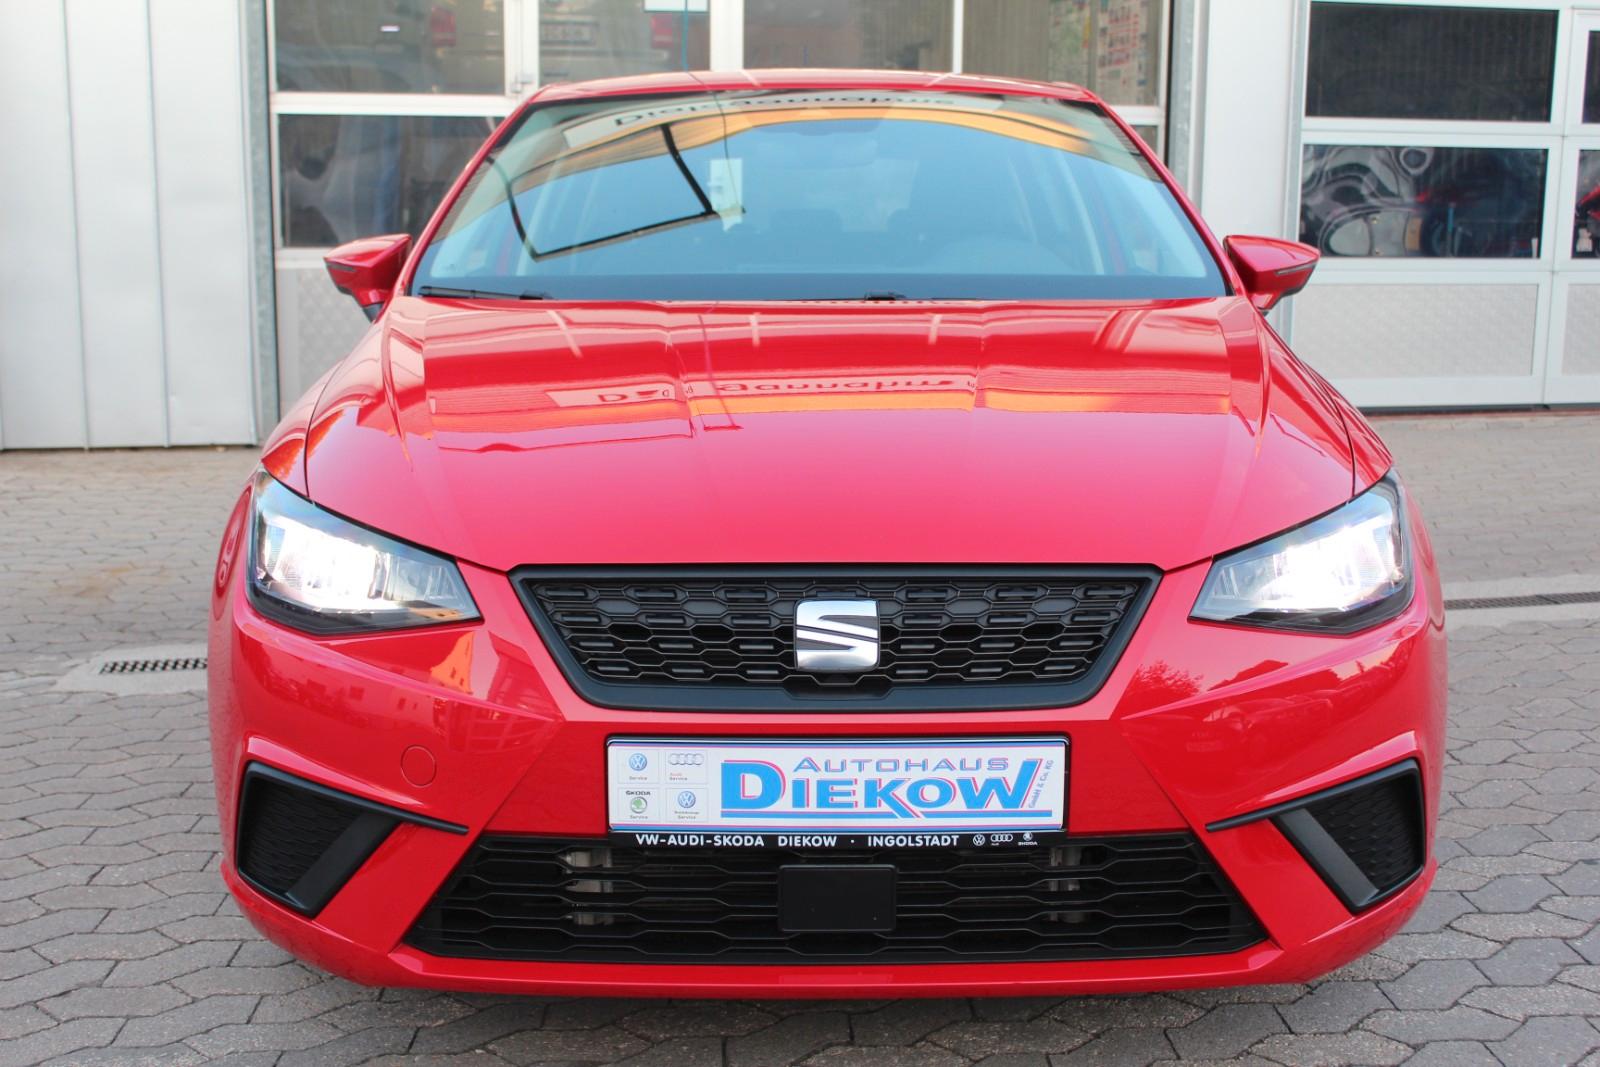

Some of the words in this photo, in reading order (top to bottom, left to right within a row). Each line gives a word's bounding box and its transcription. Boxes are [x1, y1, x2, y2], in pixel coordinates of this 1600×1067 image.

[793, 756, 1009, 773] AUTOHAUS
[721, 757, 1043, 811] DIEKOW
[635, 834, 765, 847] VW-AUDI-SKODA
[778, 835, 837, 847] DIEKOW
[867, 834, 960, 847] INGOLSTADT
